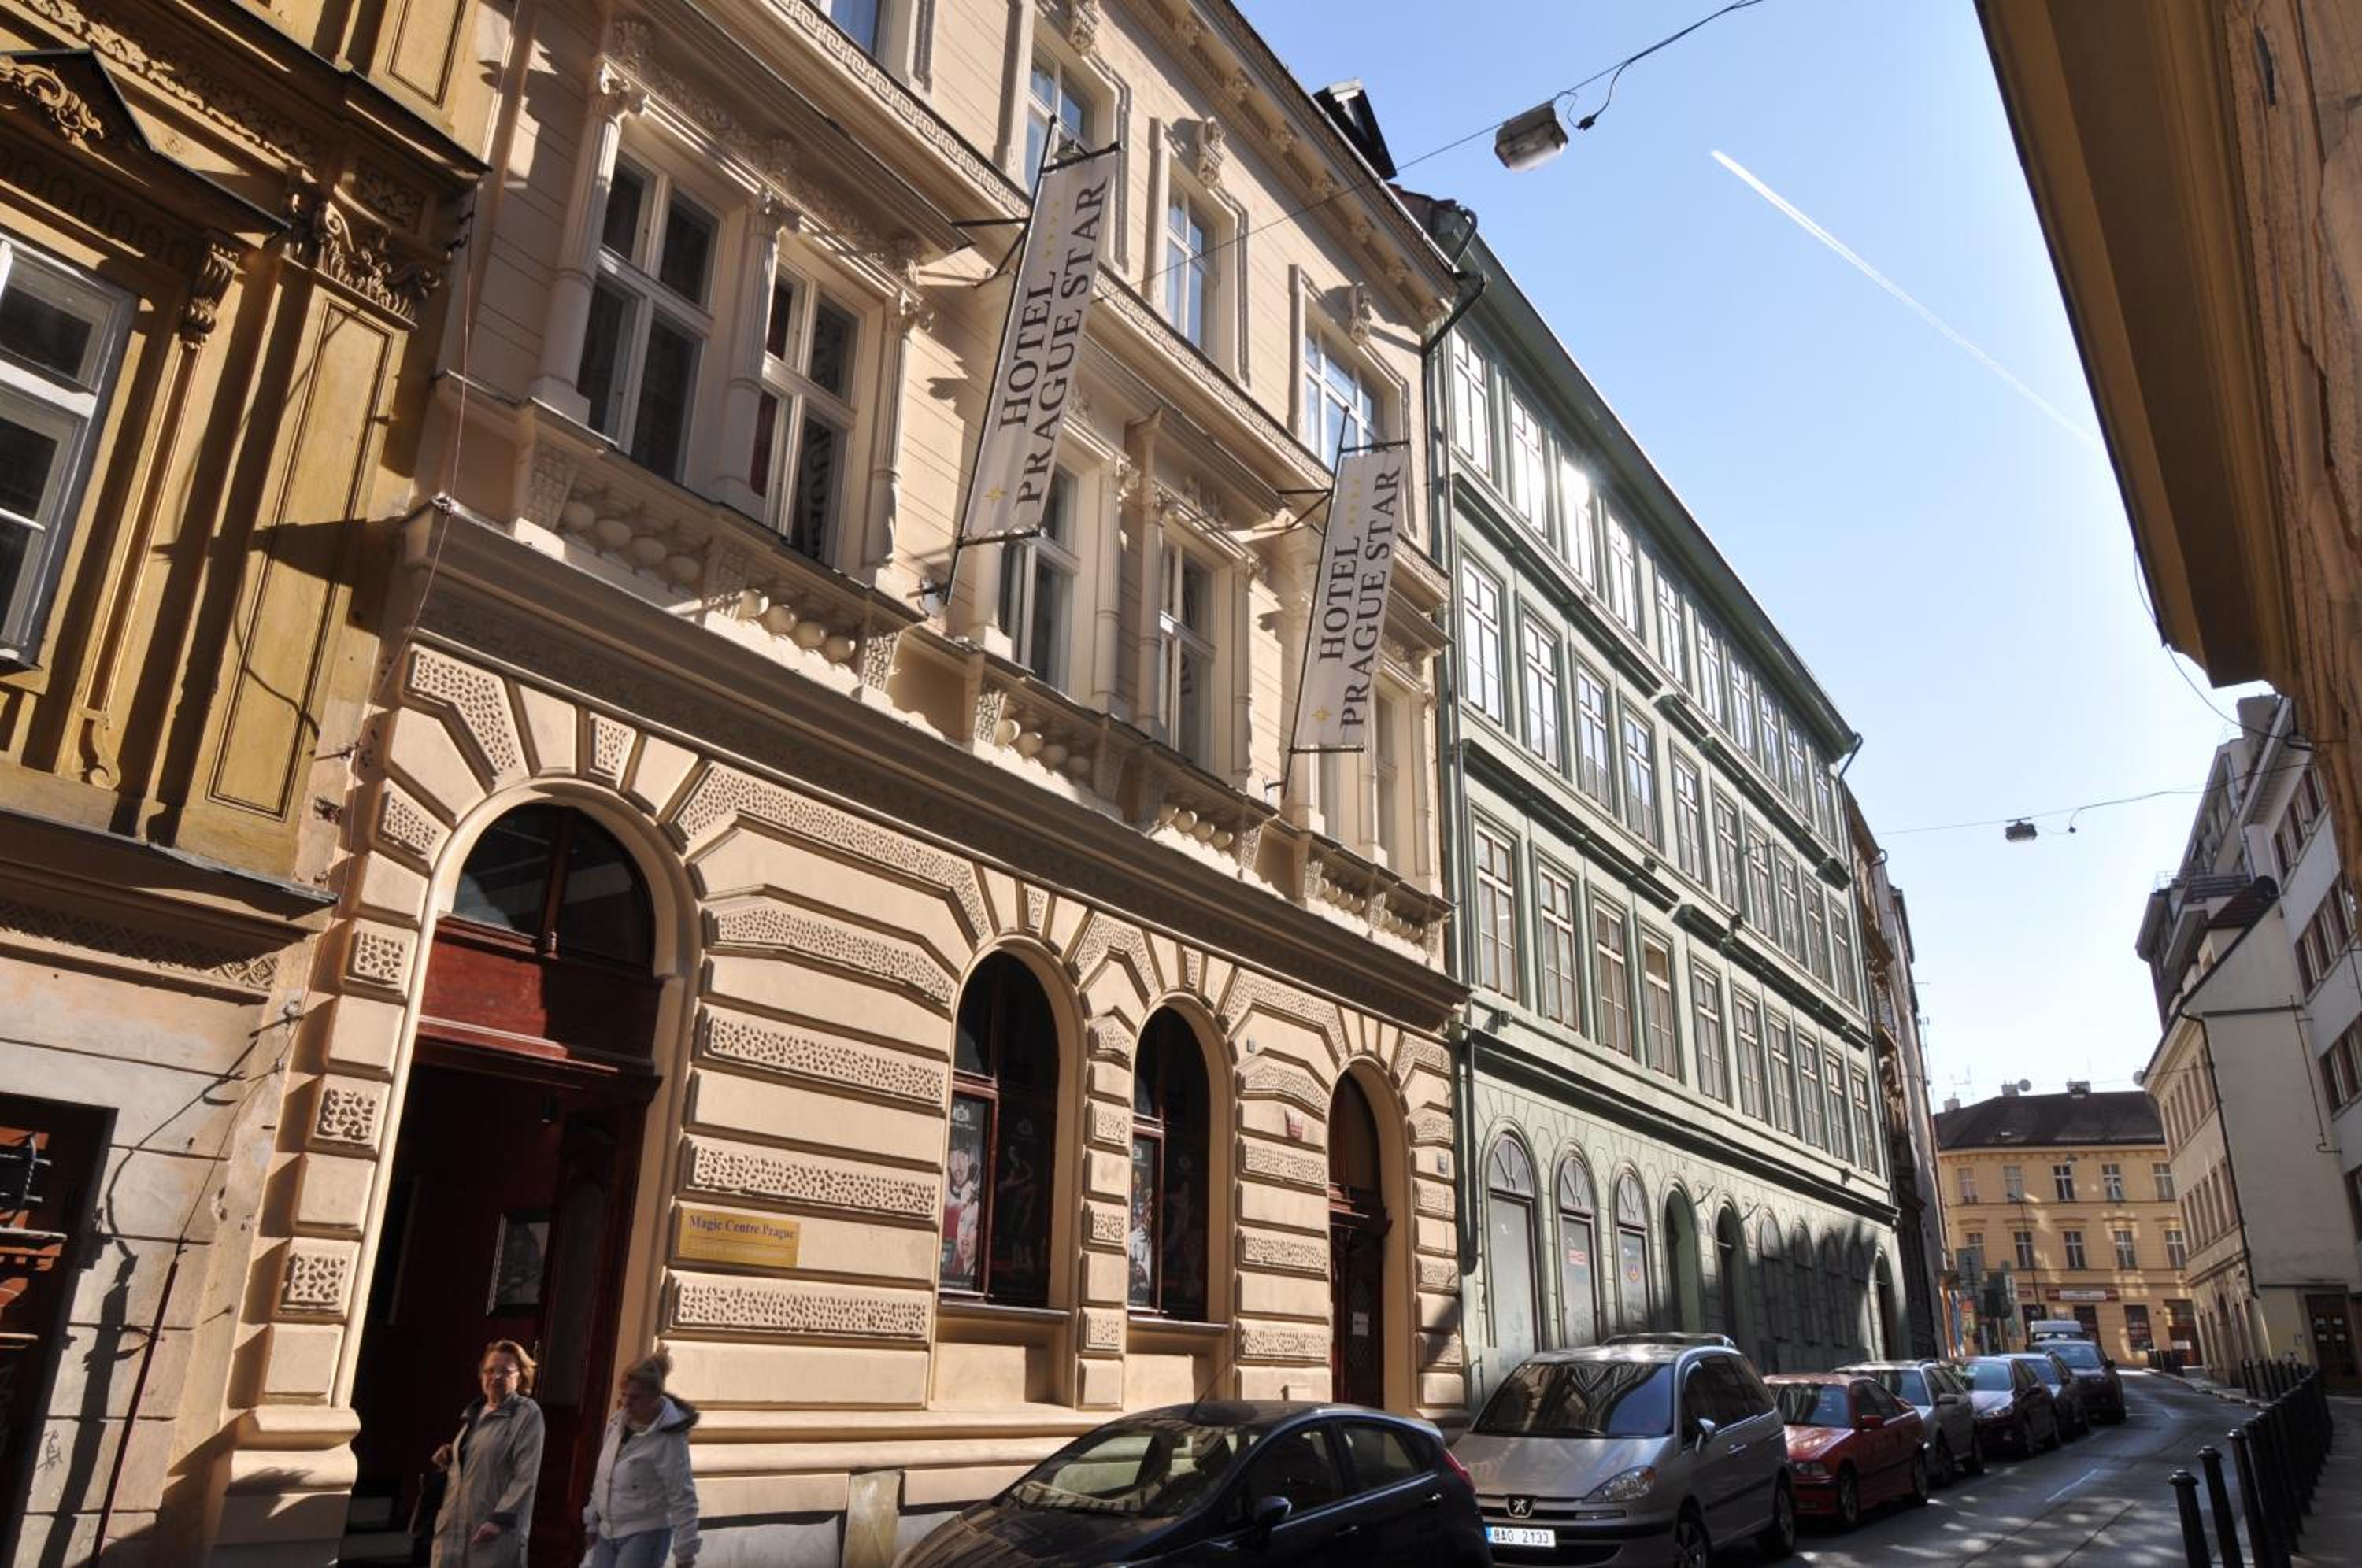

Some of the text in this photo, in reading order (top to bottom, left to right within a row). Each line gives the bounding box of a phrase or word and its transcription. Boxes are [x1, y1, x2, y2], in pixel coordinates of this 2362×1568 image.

[998, 270, 1057, 430] HOTEL
[1014, 176, 1109, 508] PRAGUE STAR
[1319, 535, 1361, 663] HOTEL
[1341, 466, 1401, 729] PRAGUE STAR
[690, 1215, 723, 1232] Magic
[725, 1220, 760, 1234] Centre
